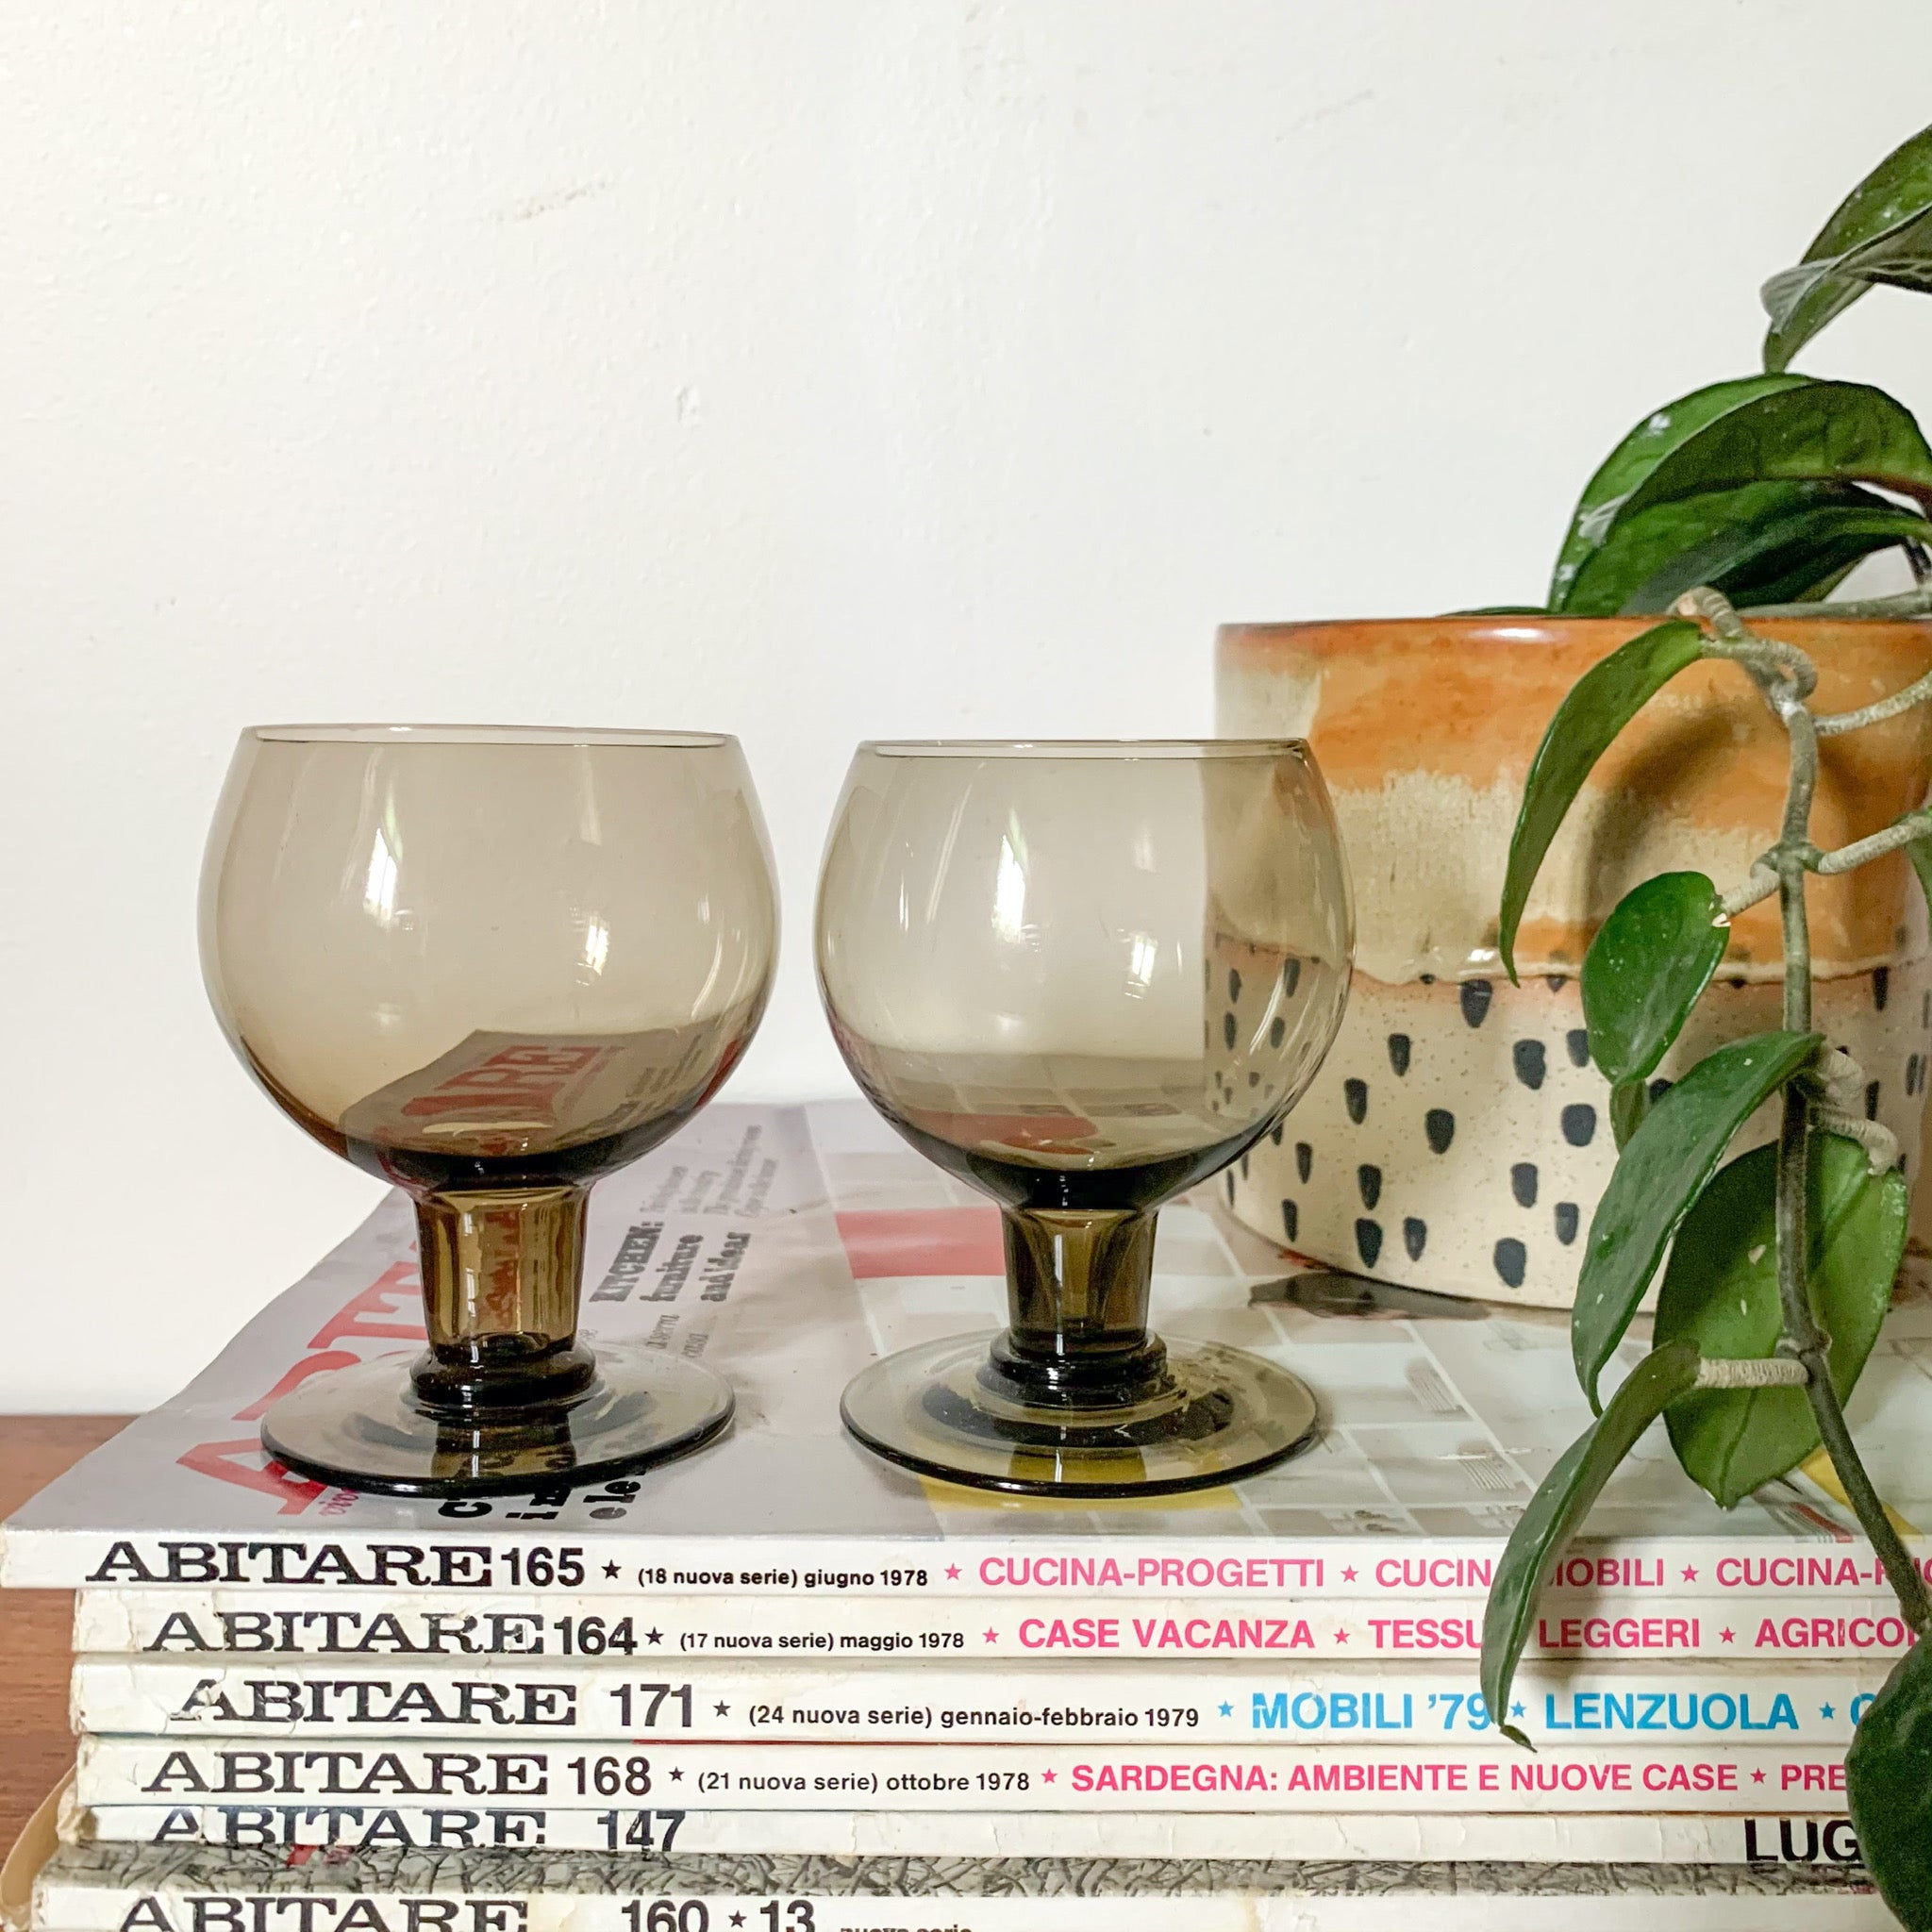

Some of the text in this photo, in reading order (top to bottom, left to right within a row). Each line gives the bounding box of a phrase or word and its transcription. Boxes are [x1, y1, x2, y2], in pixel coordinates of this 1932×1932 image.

[85, 1541, 492, 1587] ABITARE
[501, 1547, 585, 1587] 165
[639, 1568, 667, 1587] (18
[674, 1572, 734, 1585] nuova
[741, 1569, 798, 1588] serie)
[804, 1569, 874, 1589] giugno
[880, 1570, 927, 1586] 1978
[980, 1557, 1323, 1587] CUCINA-PROGETTI
[142, 1612, 544, 1652] ABITARE
[553, 1616, 637, 1656] 164
[680, 1633, 708, 1652] (17
[714, 1636, 773, 1648] nuova
[779, 1633, 834, 1651] serie)
[841, 1632, 913, 1652] maggio
[919, 1633, 964, 1648] 1978
[1020, 1619, 1119, 1648] CASE
[1133, 1620, 1314, 1648] VACANZA
[1368, 1619, 1484, 1648] TESSU
[1539, 1619, 1699, 1647] LEGGERI
[170, 1679, 576, 1725] ABITARE
[610, 1684, 691, 1727] 171
[749, 1705, 784, 1726] (24
[792, 1709, 859, 1724] nuova
[868, 1707, 932, 1728] serie)
[941, 1707, 1138, 1728] gennaio-febbraio
[1145, 1708, 1198, 1726] 1979
[1253, 1692, 1412, 1729] MOBILI
[1546, 1693, 1799, 1730] LENZUOLA
[141, 1752, 548, 1794] ABITARE
[568, 1757, 651, 1796] 168
[698, 1773, 728, 1793] (21
[740, 1777, 806, 1790] nuova
[814, 1773, 877, 1793] serie)
[887, 1774, 969, 1790] ottobre
[976, 1773, 1029, 1790] 1978
[1072, 1765, 1276, 1791] SARDEGNA:
[1289, 1765, 1467, 1790] AMBIENTE
[1479, 1765, 1499, 1790] E
[1511, 1764, 1632, 1790] NUOVE
[1643, 1764, 1738, 1790] CASE
[153, 1807, 545, 1848] ABITARE
[596, 1810, 686, 1854] 147
[118, 1897, 528, 1932] ABITARE
[621, 1900, 709, 1932] 160
